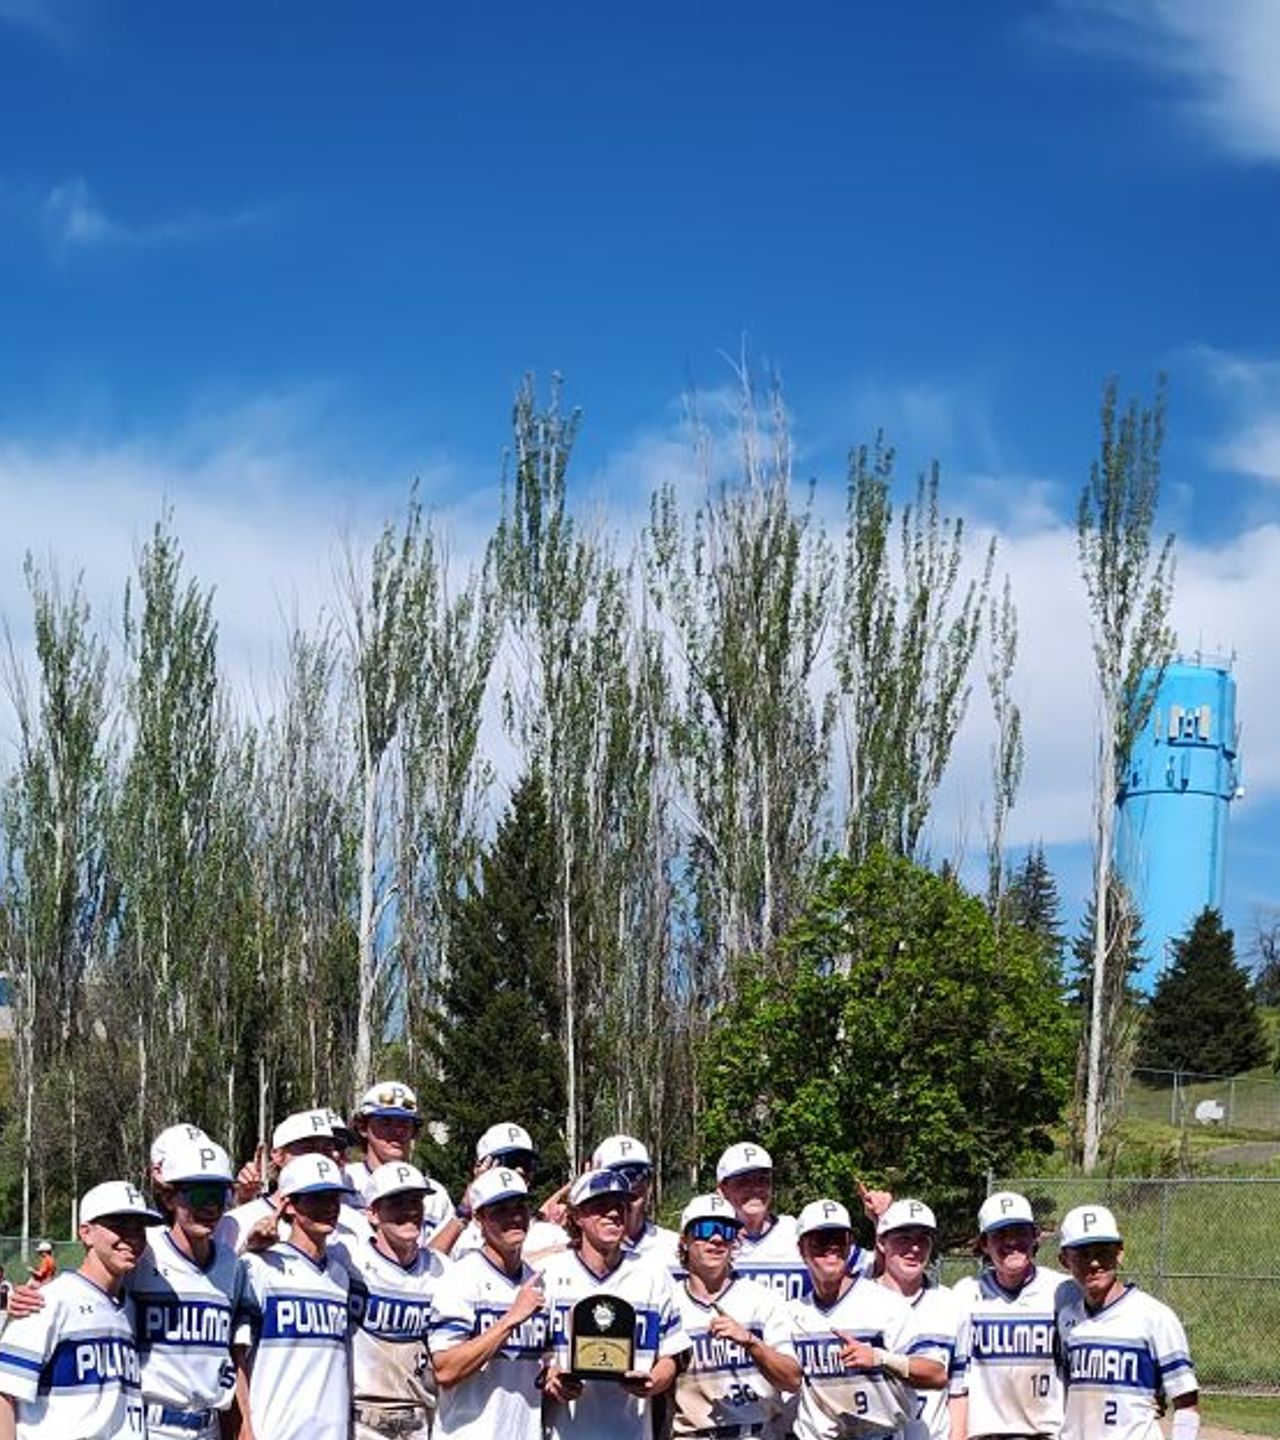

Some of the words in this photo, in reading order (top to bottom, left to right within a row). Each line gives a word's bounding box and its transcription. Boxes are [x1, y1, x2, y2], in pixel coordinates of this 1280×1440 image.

[508, 1127, 521, 1142] P
[619, 1141, 633, 1156] P
[744, 1147, 757, 1162] P
[200, 1148, 216, 1169] P
[316, 1161, 330, 1178] P
[396, 1166, 410, 1182] P
[499, 1171, 513, 1187] P
[822, 1201, 837, 1219] P
[909, 1201, 924, 1218] P
[1000, 1199, 1014, 1214] P
[1082, 1213, 1096, 1232] P
[1031, 1374, 1050, 1398] 10
[853, 1391, 868, 1415] 9
[1104, 1401, 1118, 1425] 2
